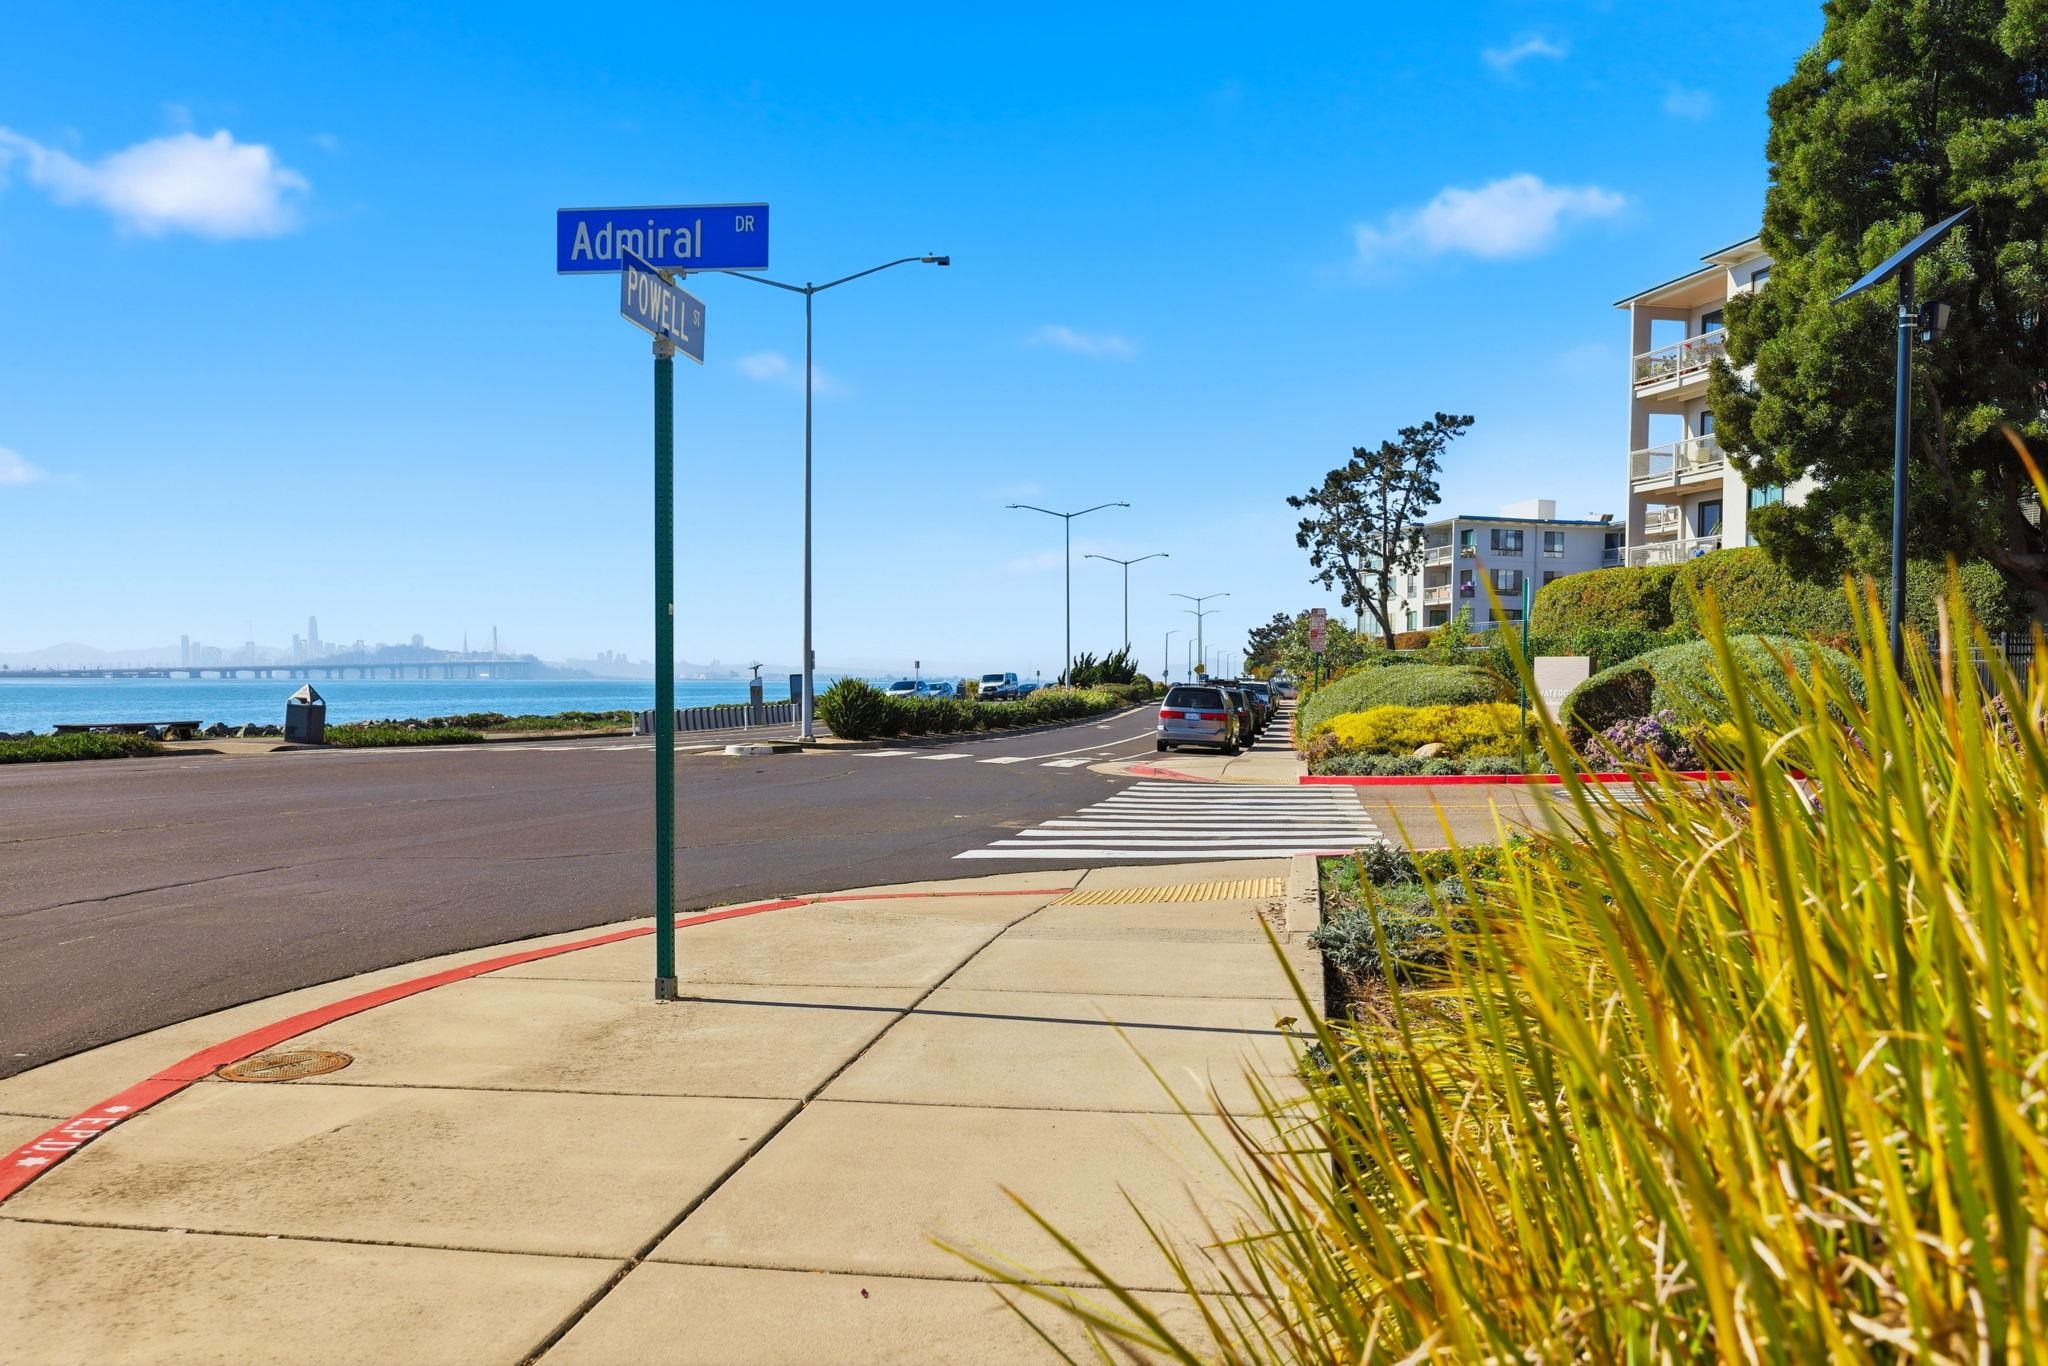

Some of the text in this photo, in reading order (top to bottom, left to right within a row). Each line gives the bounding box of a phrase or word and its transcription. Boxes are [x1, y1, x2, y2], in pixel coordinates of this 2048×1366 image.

[572, 216, 755, 260] Admiral DR
[628, 266, 701, 341] POWELL ST
